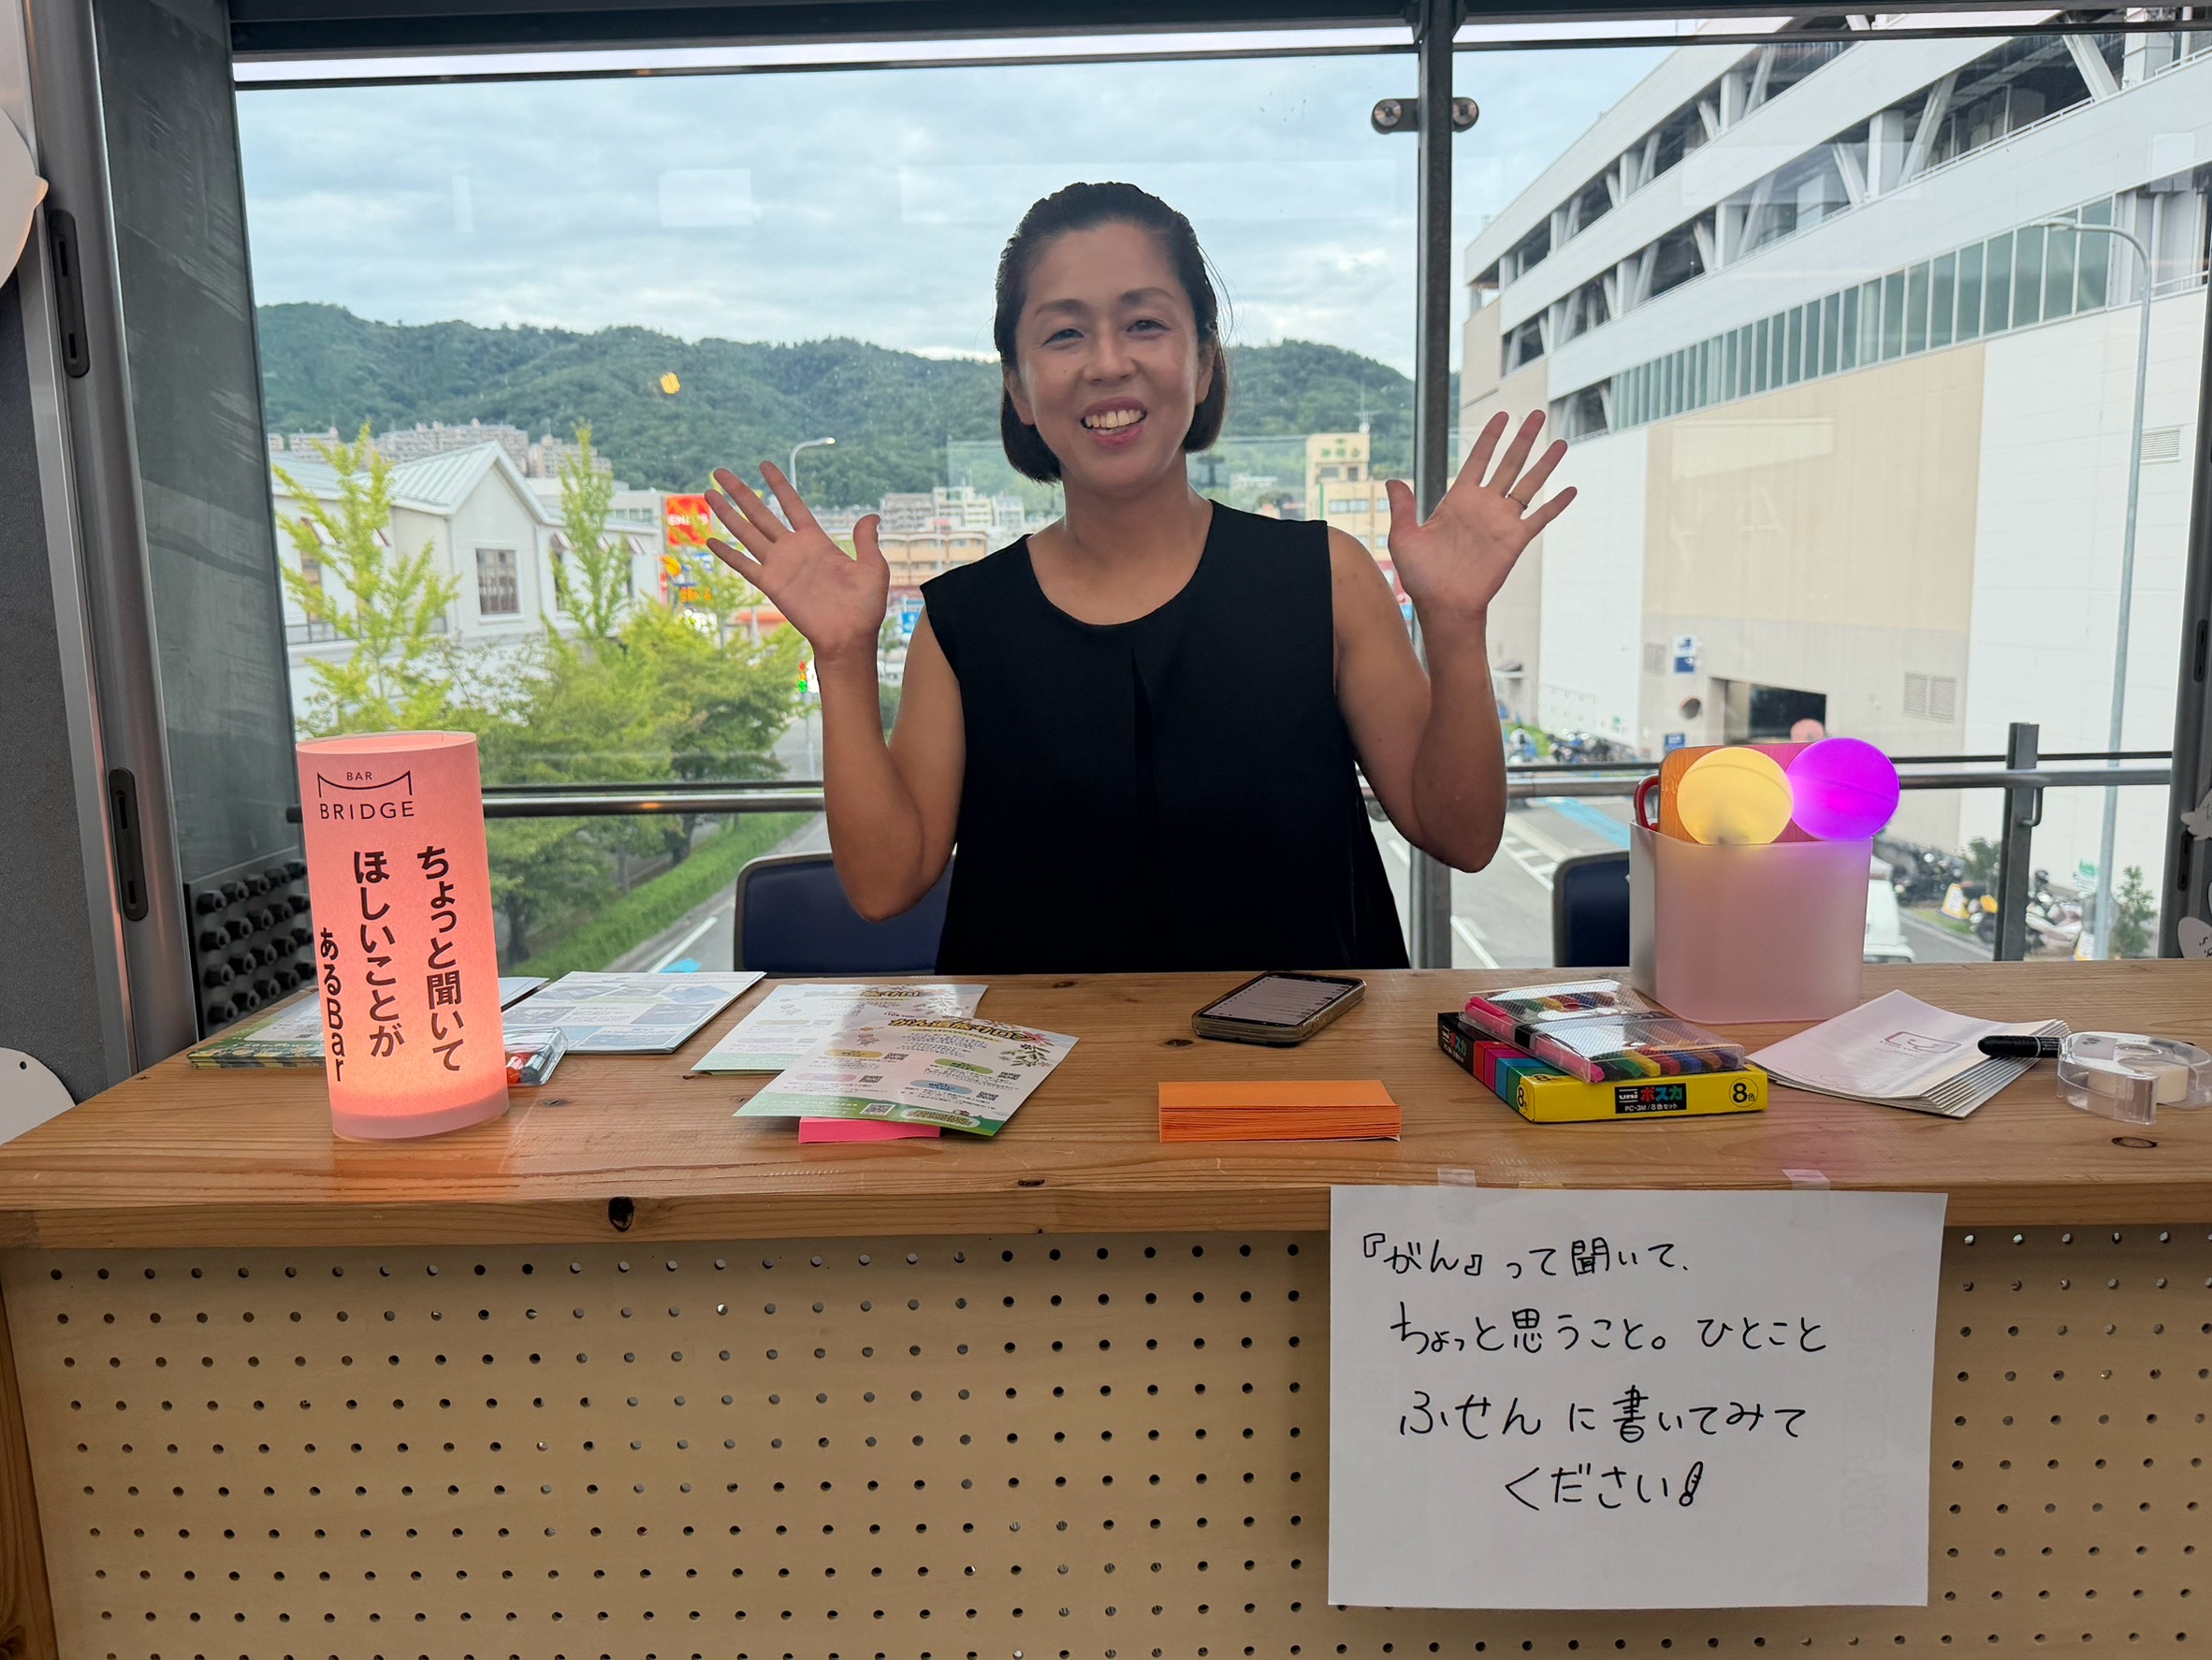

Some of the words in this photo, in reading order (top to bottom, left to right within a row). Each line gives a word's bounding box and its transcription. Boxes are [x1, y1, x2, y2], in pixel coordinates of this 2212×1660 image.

[319, 800, 415, 821] BRIDGE
[346, 771, 372, 781] BAR
[353, 851, 405, 1057] ほしいことが
[416, 845, 464, 1071] ちょっと聞いて
[320, 927, 345, 1082] あるBar
[1640, 1085, 1682, 1102] ポスカ
